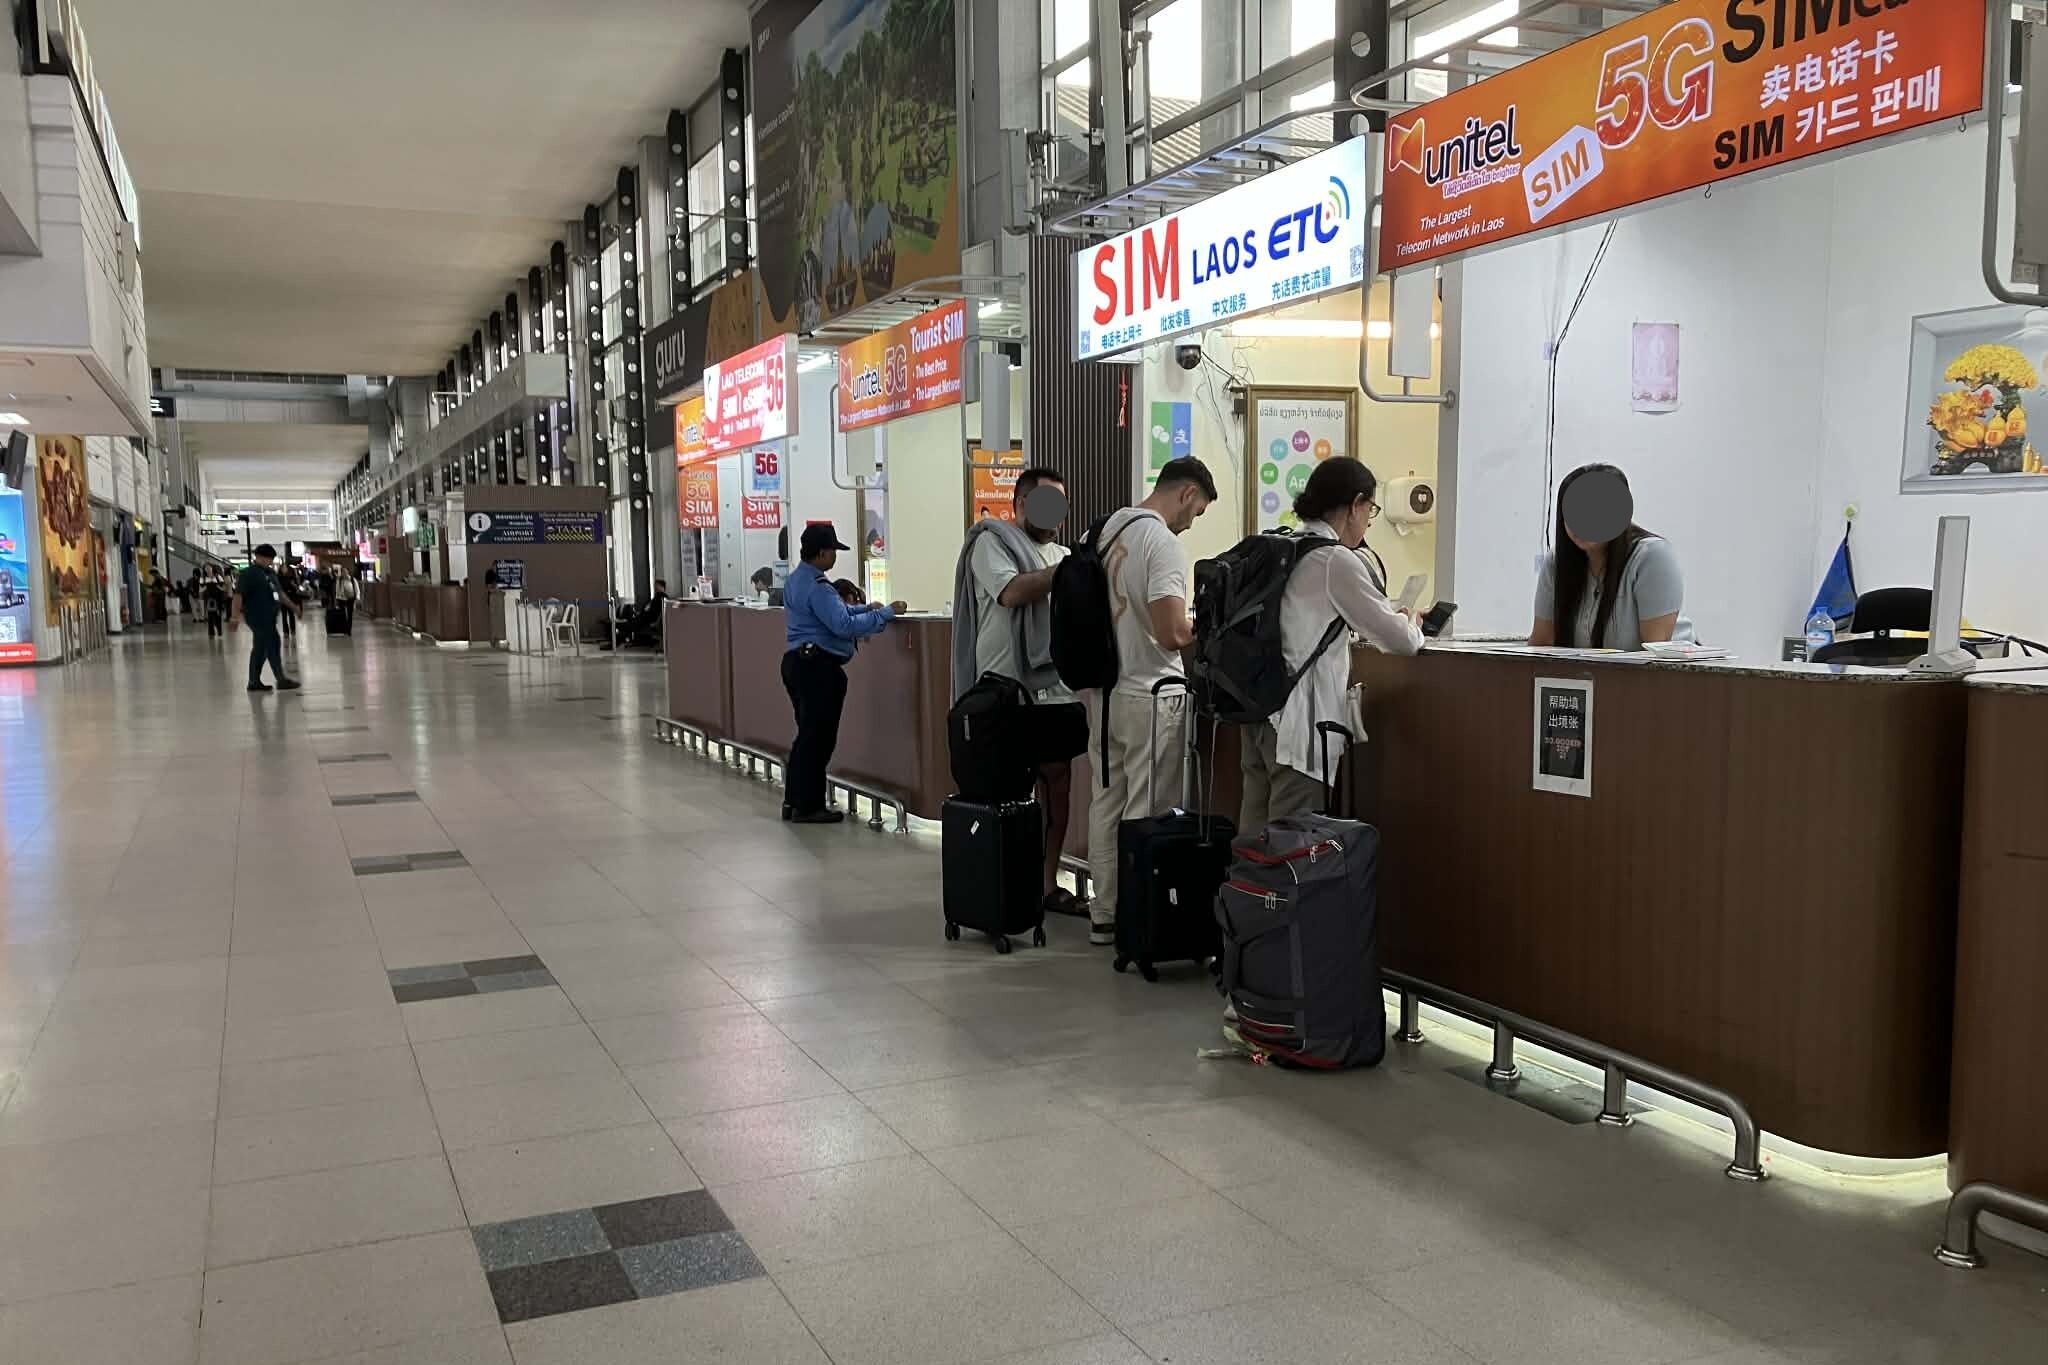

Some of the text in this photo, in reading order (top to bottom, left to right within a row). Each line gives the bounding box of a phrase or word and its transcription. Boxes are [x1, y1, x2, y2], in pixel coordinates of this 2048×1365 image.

[1594, 17, 1715, 150] 5G
[1760, 29, 1899, 109] 卖电话卡
[1425, 104, 1521, 187] unitel
[1713, 66, 1942, 170] SIM 카드 판매
[1531, 138, 1590, 208] SIM
[1397, 216, 1505, 257] Telecom Network in Laos
[1420, 204, 1472, 231] The Largest
[1092, 202, 1340, 326] SIM LAOS ETL
[910, 309, 964, 354] Tourist SIM
[1101, 266, 1332, 349] 电话卡上网卡 批发零售 中文服务 充话费充流量
[655, 328, 686, 390] guru
[852, 343, 907, 403] unitel 5G
[682, 515, 717, 527] e-SIM
[685, 500, 713, 514] SIM
[745, 513, 778, 526] e-SIM
[747, 501, 774, 512] SIM
